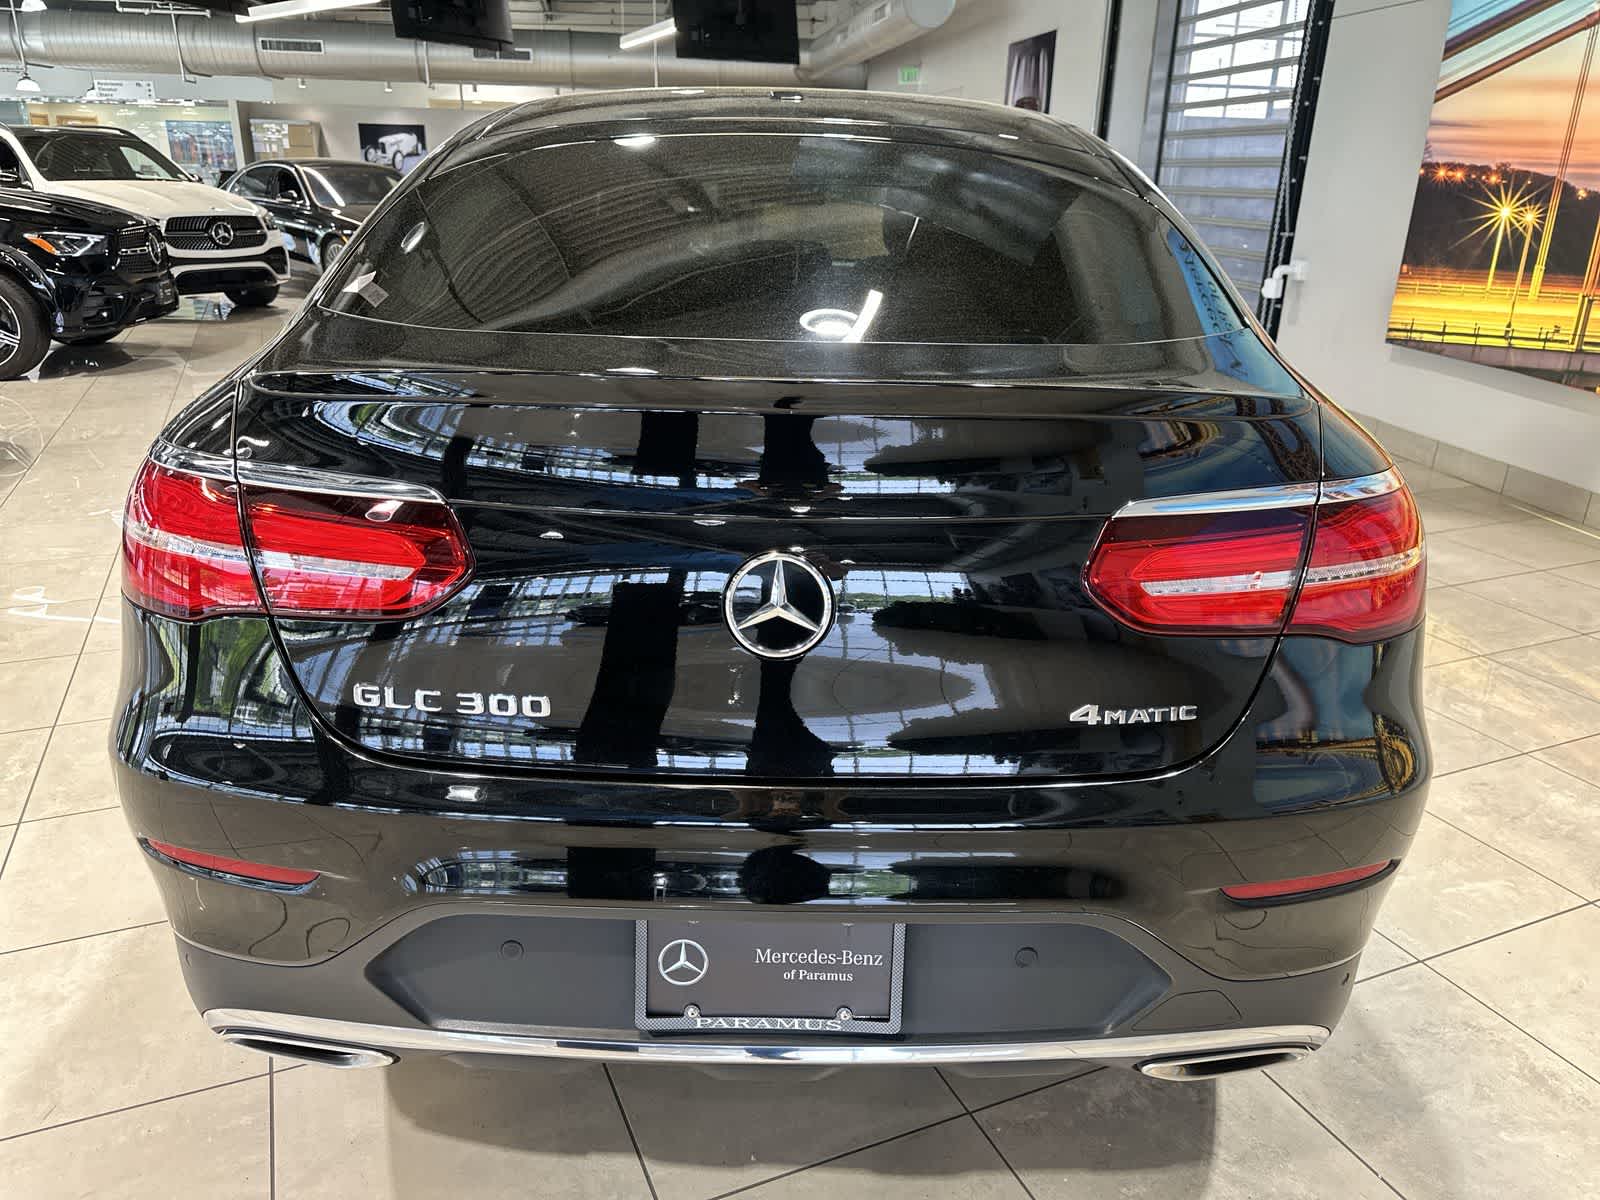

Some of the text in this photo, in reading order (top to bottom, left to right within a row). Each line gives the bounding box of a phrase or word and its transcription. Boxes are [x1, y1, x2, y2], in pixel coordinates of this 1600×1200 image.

[353, 683, 551, 718] GLC 300
[1069, 704, 1198, 725] 4MATIC
[754, 948, 883, 966] Mercedes-Benz
[783, 969, 853, 982] of Paramus
[695, 1017, 842, 1031] PARAMUS
